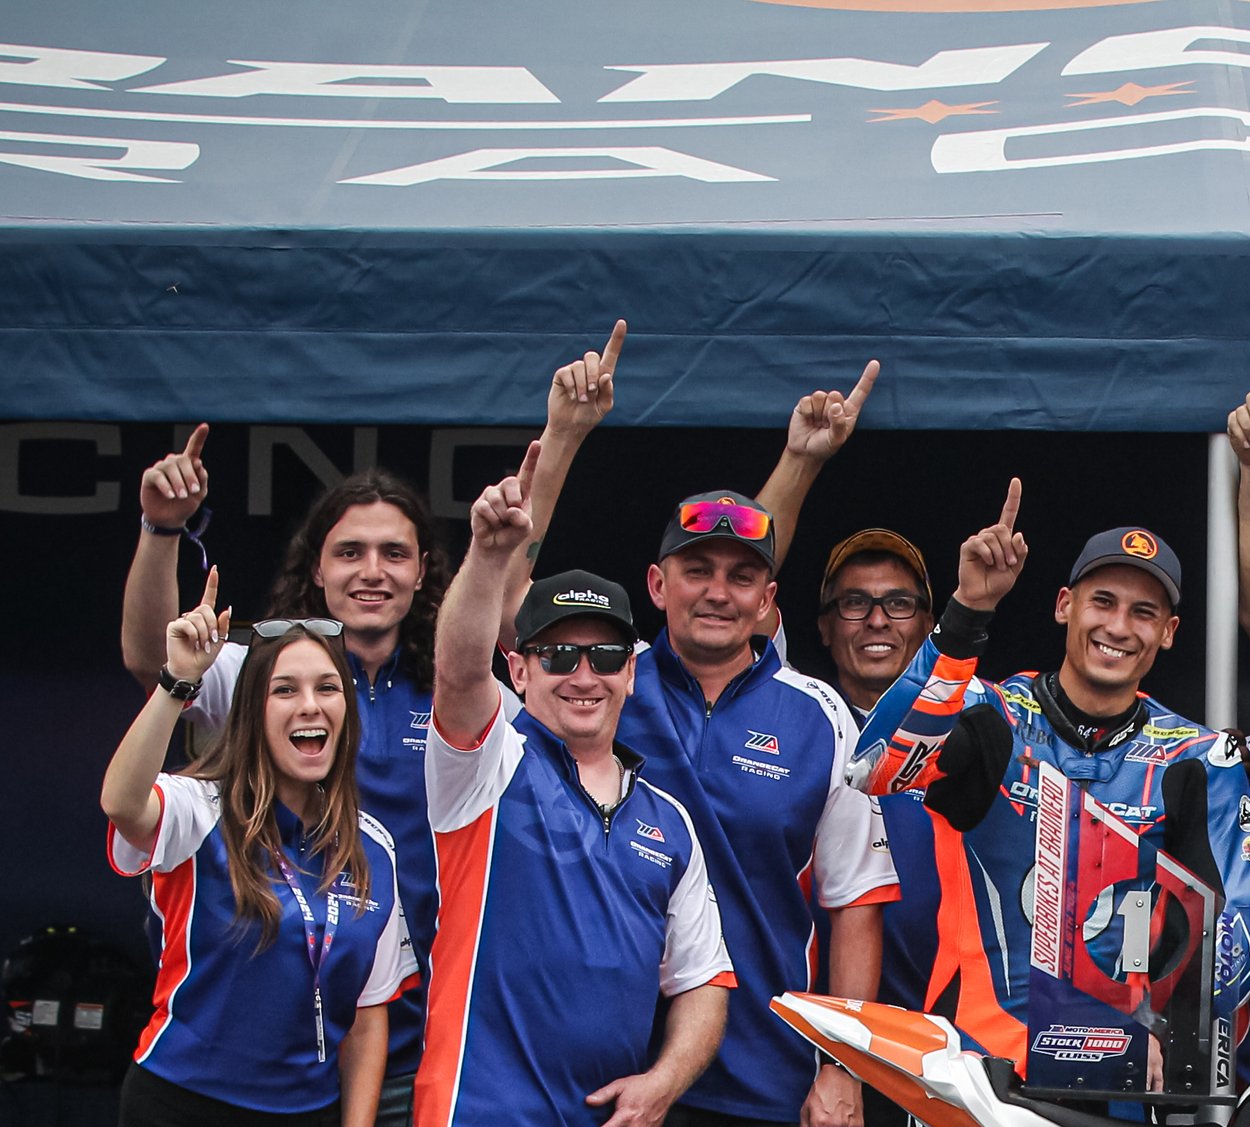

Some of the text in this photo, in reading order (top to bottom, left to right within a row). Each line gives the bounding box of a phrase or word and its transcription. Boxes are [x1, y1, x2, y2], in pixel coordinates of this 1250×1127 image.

[557, 589, 610, 602] alpha
[741, 765, 781, 780] RACING
[1034, 775, 1064, 973] SUPERBIKES AT BRAINERD
[292, 887, 315, 922] 2024
[1116, 891, 1152, 973] 1
[1065, 1026, 1123, 1035] MOTOAMERICA
[1040, 1037, 1124, 1049] STOCK 1000
[1058, 1052, 1100, 1060] CLASS
